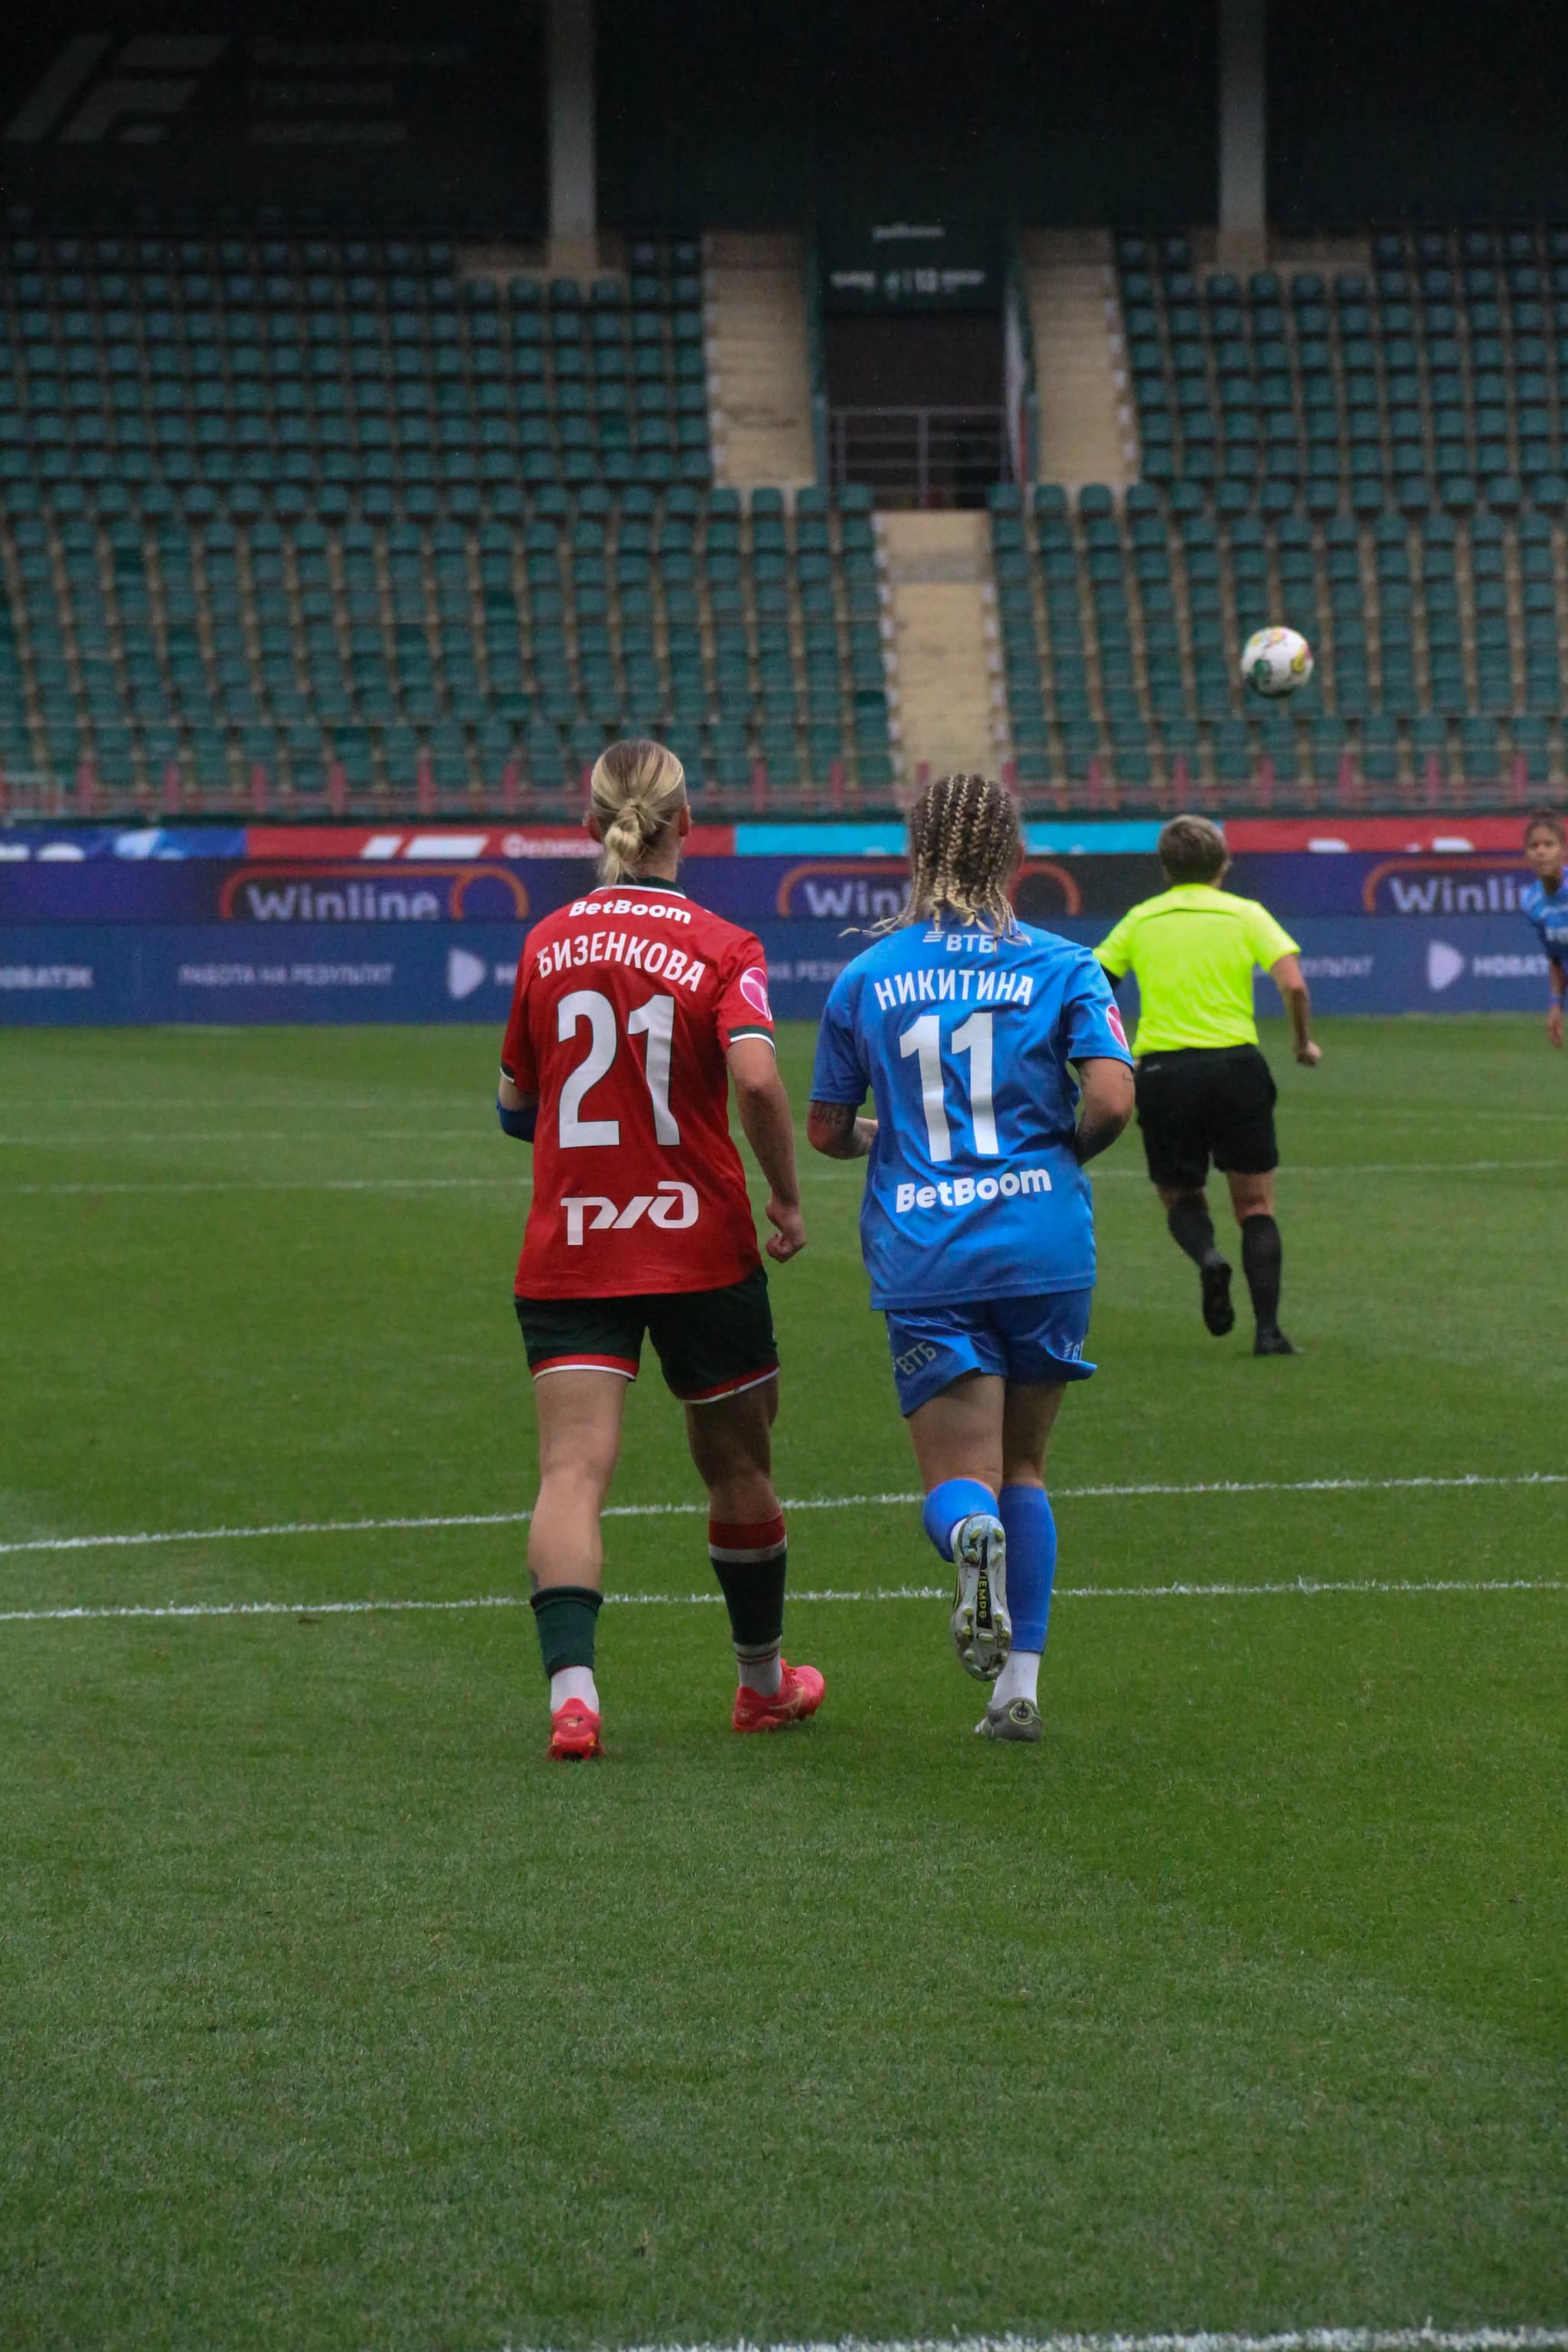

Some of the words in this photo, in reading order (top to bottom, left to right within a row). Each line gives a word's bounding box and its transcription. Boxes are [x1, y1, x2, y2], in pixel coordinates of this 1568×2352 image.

[247, 882, 441, 919] Winline
[568, 899, 691, 925] BetBoom
[537, 931, 706, 992] БИЗЕНКОВА
[946, 933, 996, 954] ВТБ
[874, 968, 1034, 1011] НИКИТИНА
[557, 990, 681, 1148] 21
[899, 1012, 999, 1162] 11
[895, 1168, 1053, 1214] BetBoom
[895, 1341, 937, 1376] ВТБ
